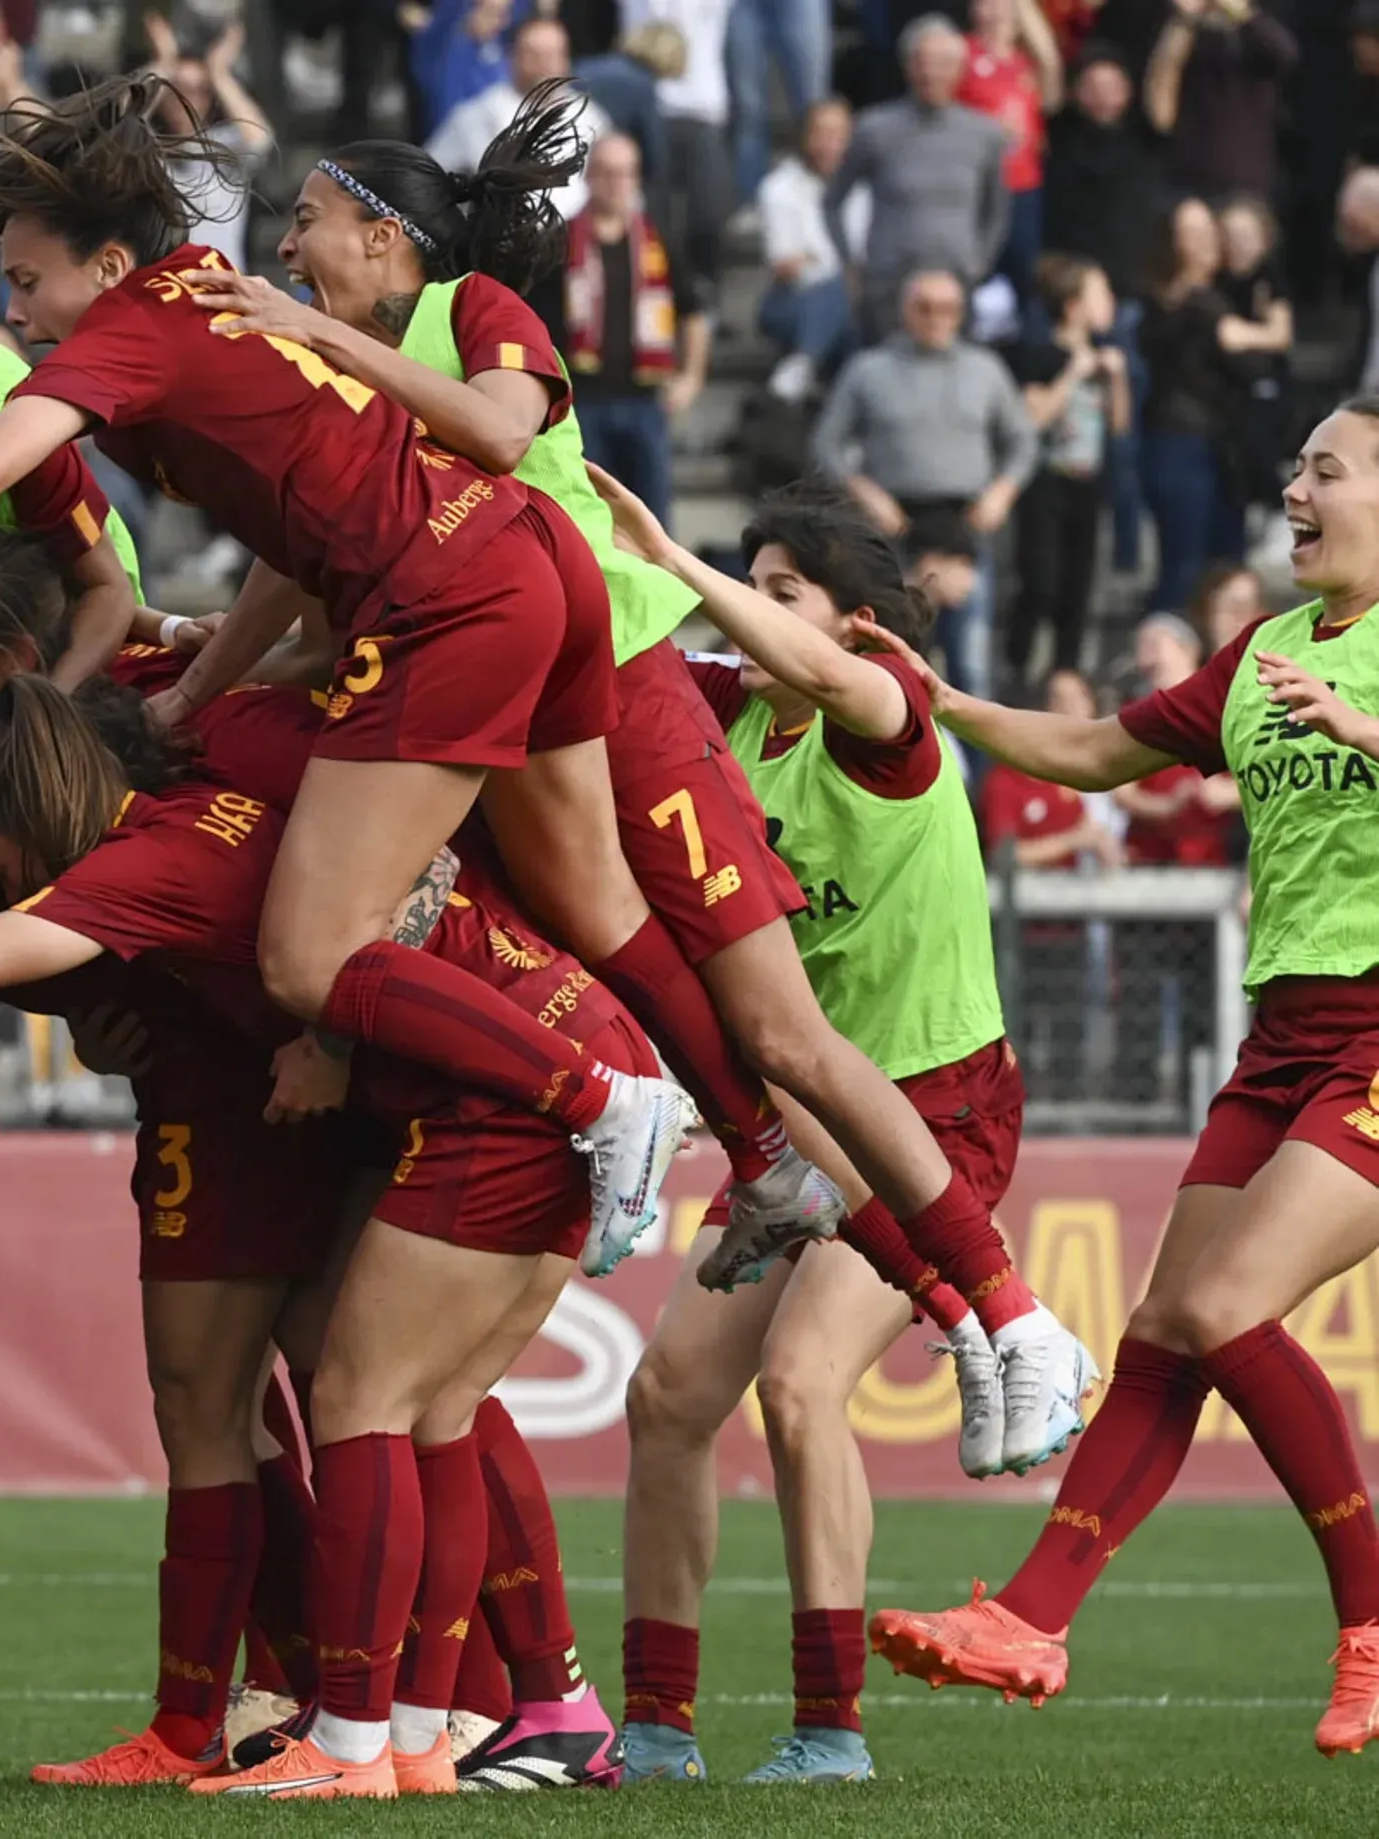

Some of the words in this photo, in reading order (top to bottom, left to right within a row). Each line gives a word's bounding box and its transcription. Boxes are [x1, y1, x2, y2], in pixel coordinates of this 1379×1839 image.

[1237, 751, 1377, 802] TOYOTA
[649, 788, 707, 880] 7
[155, 1124, 192, 1207] 3
